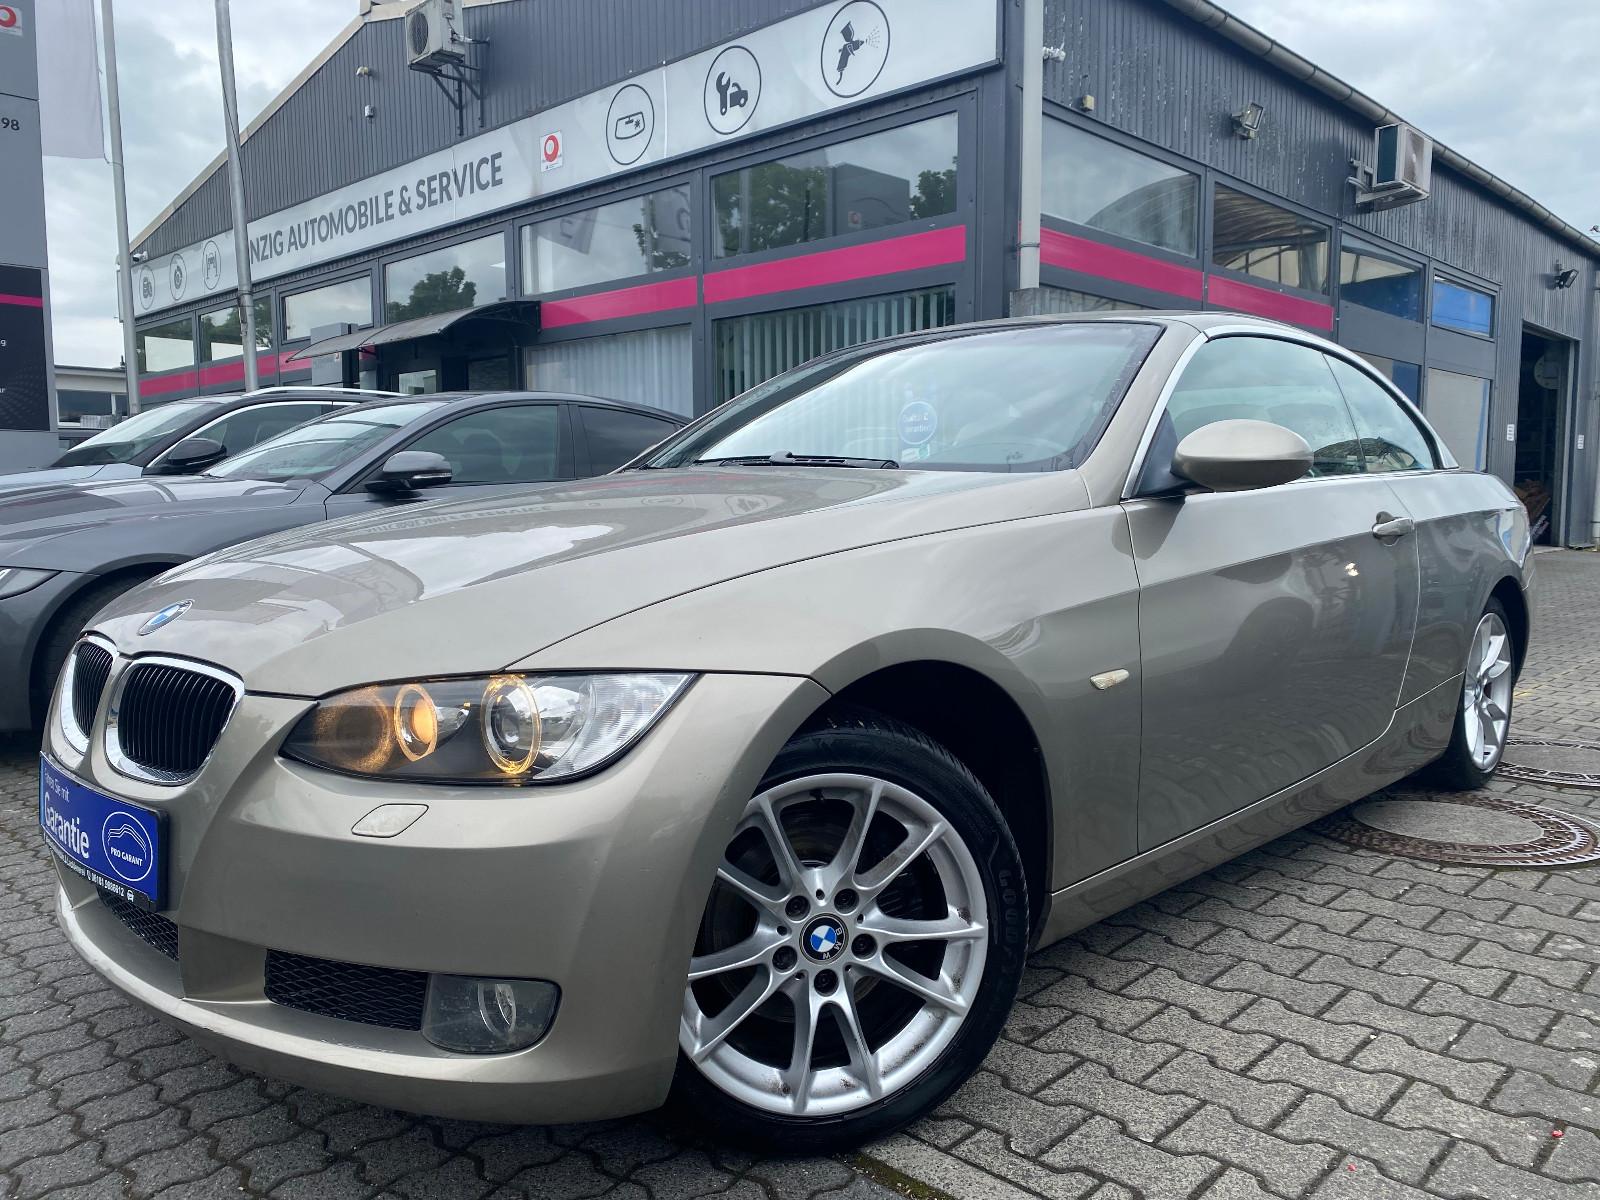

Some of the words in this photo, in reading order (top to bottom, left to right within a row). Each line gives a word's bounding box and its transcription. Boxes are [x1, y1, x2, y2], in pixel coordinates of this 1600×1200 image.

[250, 229, 284, 264] NZIG
[287, 189, 395, 254] AUTOMOBILE
[399, 185, 413, 216] &
[415, 152, 503, 211] SERVICE
[44, 791, 90, 859] Garantie
[110, 846, 121, 858] PRO
[121, 852, 143, 867] GARANT
[822, 927, 843, 960] BMW
